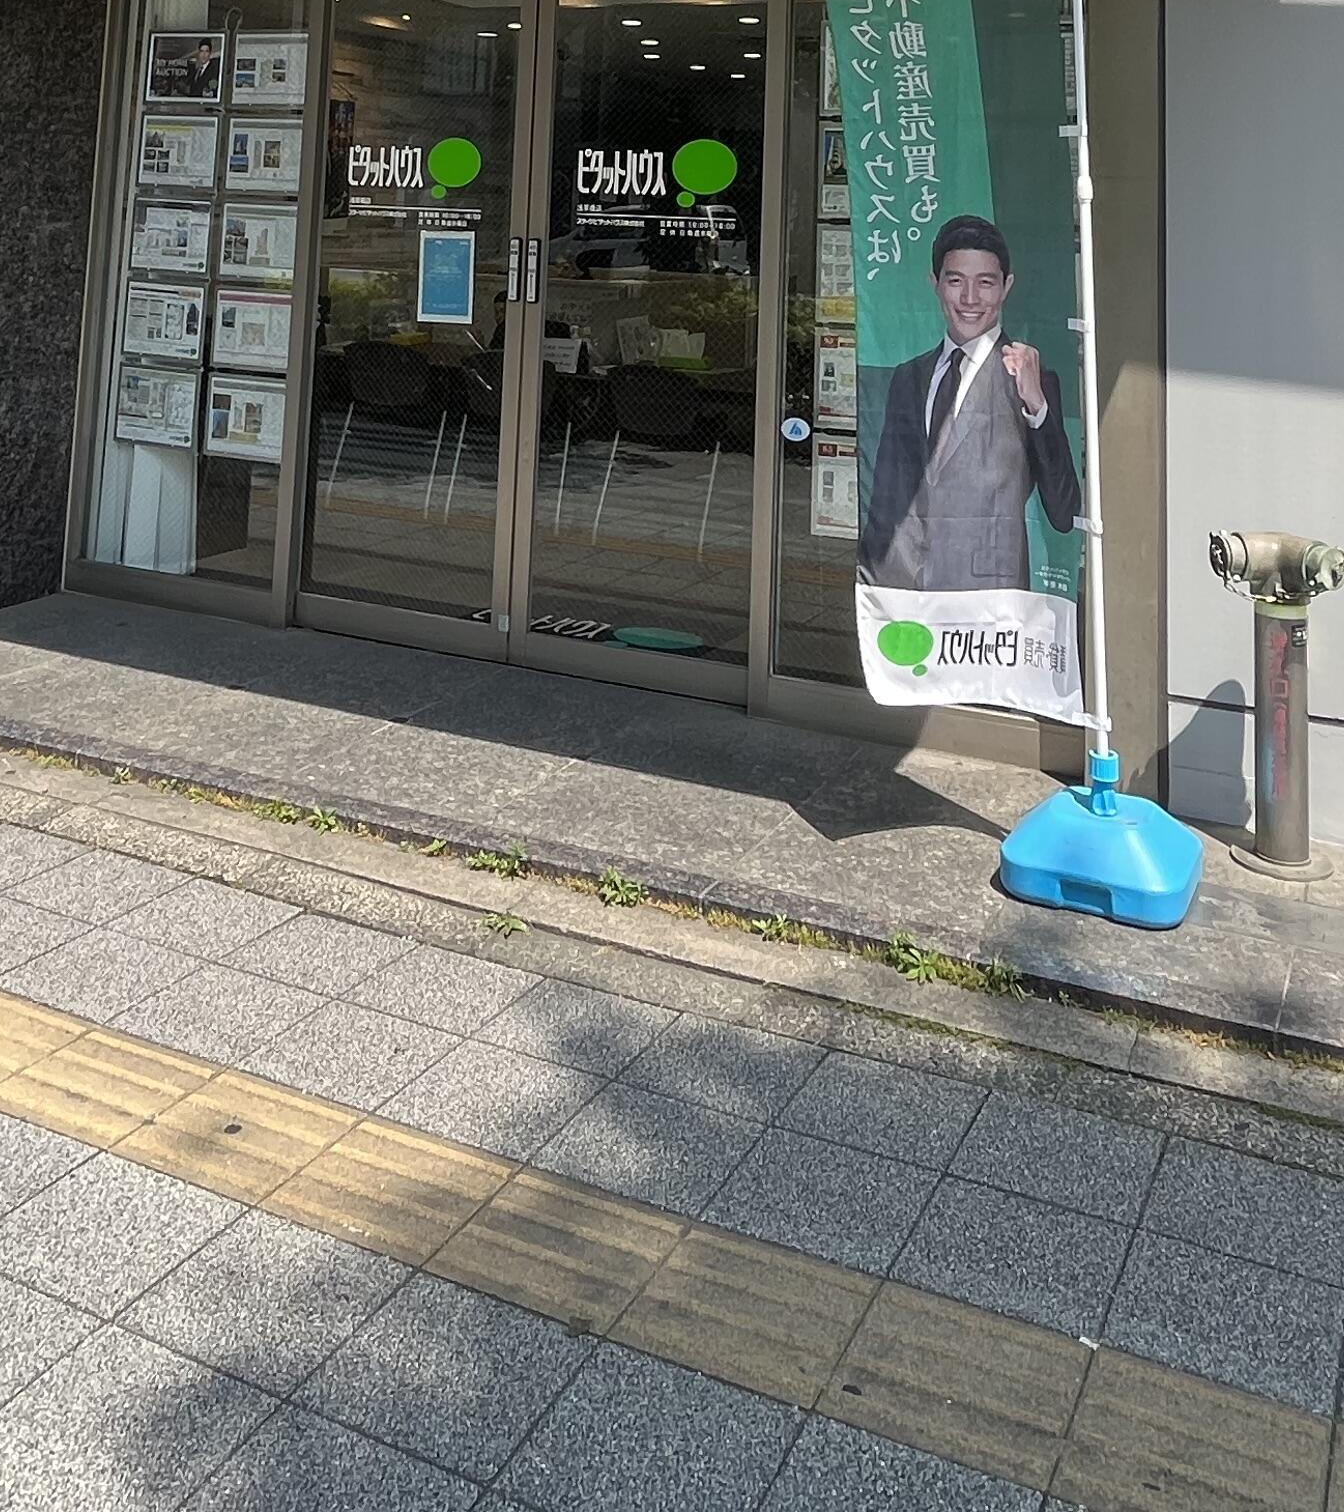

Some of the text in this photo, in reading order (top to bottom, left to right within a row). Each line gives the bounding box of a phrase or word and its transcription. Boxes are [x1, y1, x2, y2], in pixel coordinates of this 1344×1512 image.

[348, 144, 423, 188] ピタットハウス
[577, 148, 666, 196] ピタットハウス
